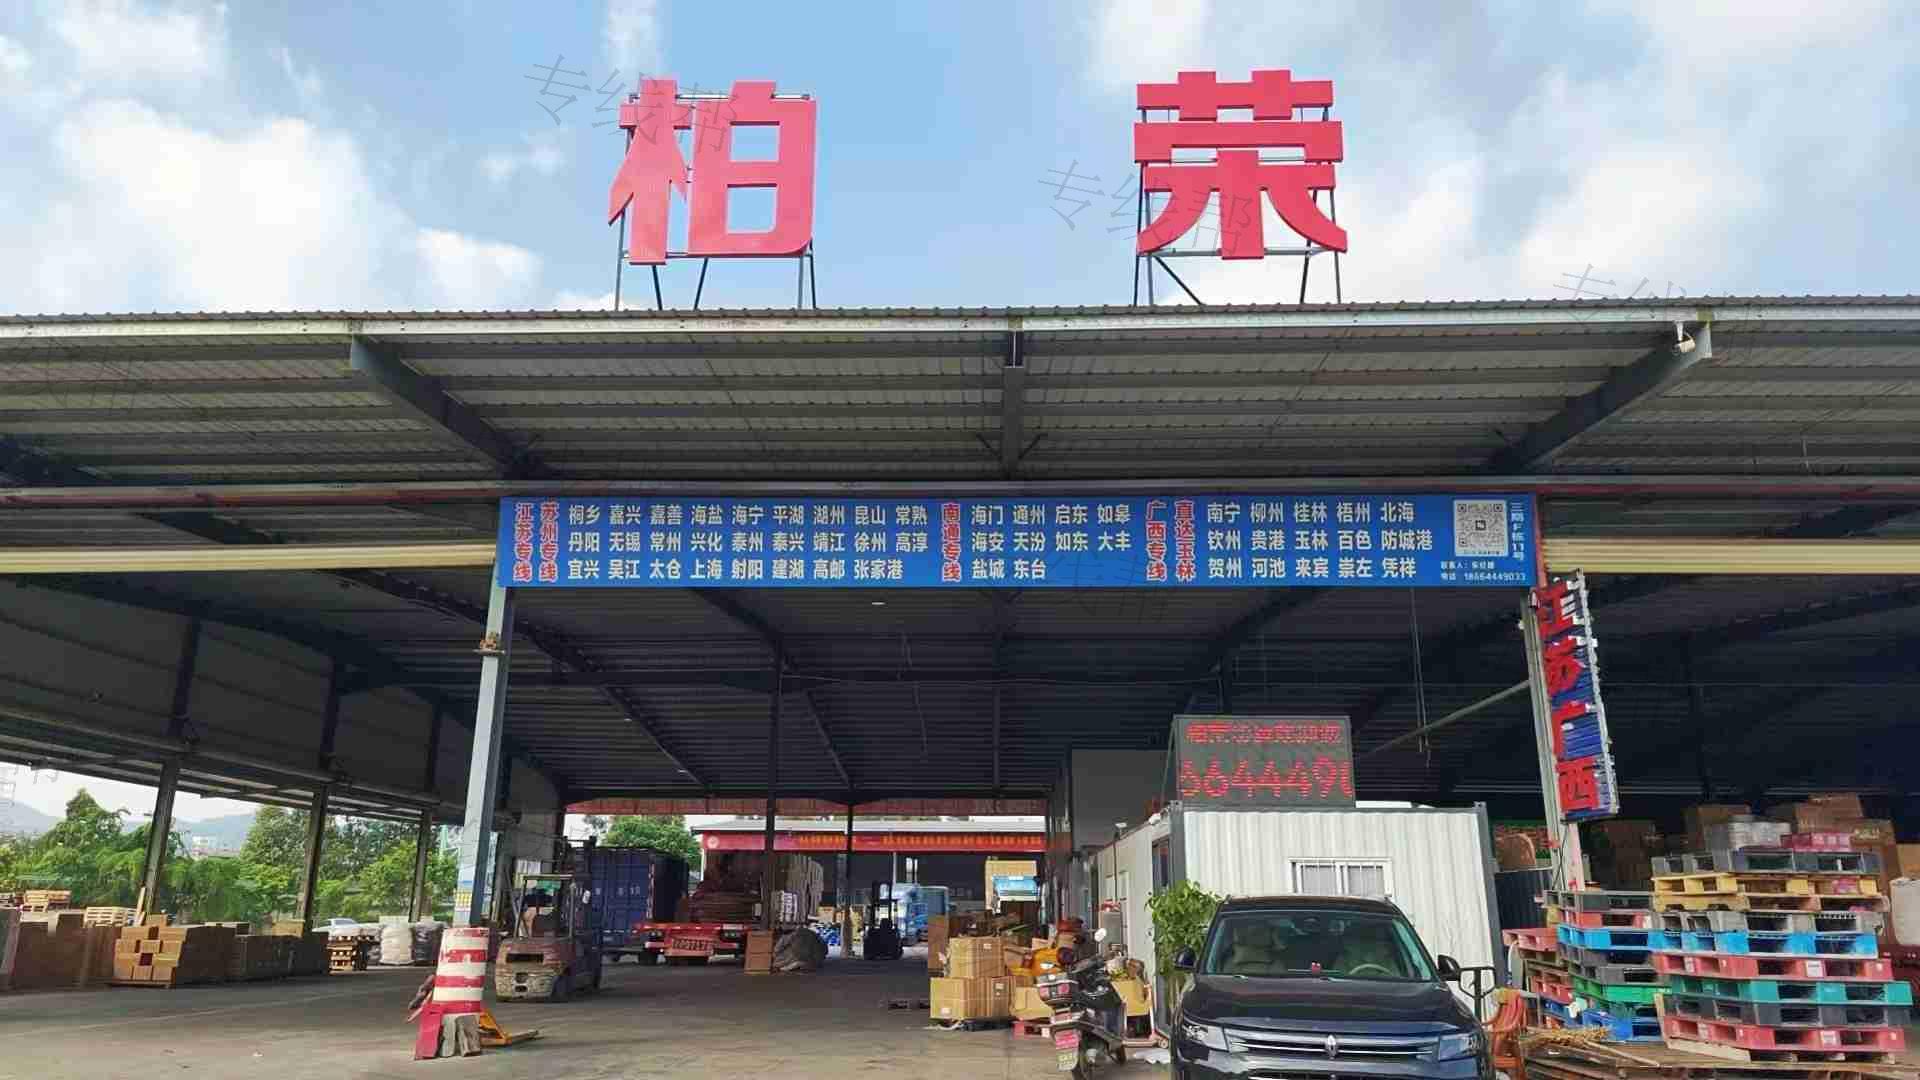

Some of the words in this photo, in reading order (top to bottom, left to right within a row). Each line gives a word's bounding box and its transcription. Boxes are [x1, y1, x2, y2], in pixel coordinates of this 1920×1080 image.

[608, 79, 817, 265] 柏
[1134, 69, 1348, 260] 荣
[569, 505, 600, 525] 桐乡
[609, 505, 640, 525] 嘉兴
[651, 505, 682, 525] 嘉善
[691, 505, 723, 525] 海盐
[732, 505, 764, 525] 海宁
[772, 505, 804, 525] 平湖
[814, 505, 845, 525] 湖州
[855, 505, 886, 525] 昆山
[896, 505, 928, 525] 常熟
[971, 504, 1003, 525] 海门
[1013, 504, 1046, 525] 通州
[1056, 504, 1088, 525] 启东
[1097, 504, 1131, 525] 如皋
[1207, 502, 1240, 523] 南宁
[1250, 502, 1283, 523] 柳州
[1294, 502, 1328, 523] 桂林
[1336, 502, 1370, 523] 梧州
[1380, 502, 1414, 523] 北海
[513, 502, 534, 582] 江苏专线
[539, 502, 559, 582] 苏州专线
[568, 532, 600, 552] 丹阳
[609, 532, 640, 552] 无锡
[650, 532, 681, 552] 常州
[691, 532, 723, 552] 兴化
[731, 532, 763, 552] 泰州
[772, 532, 804, 552] 泰兴
[813, 532, 845, 552] 靖江
[854, 532, 886, 552] 徐州
[895, 532, 928, 552] 高淳
[942, 502, 962, 582] 南通专线
[972, 531, 1003, 552] 海安
[1013, 531, 1046, 552] 天汾
[1056, 531, 1088, 552] 如东
[1098, 531, 1131, 552] 大丰
[1146, 500, 1167, 581] 广西专线
[1175, 500, 1196, 582] 直达玉林
[1207, 529, 1240, 551] 钦州
[1251, 529, 1285, 551] 贵港
[1295, 529, 1328, 551] 玉林
[1338, 529, 1372, 551] 百色
[1381, 529, 1433, 551] 防城港
[568, 559, 600, 579] 宜兴
[608, 559, 640, 579] 吴江
[650, 559, 681, 579] 太仓
[690, 559, 723, 579] 上海
[731, 559, 763, 579] 射阳
[772, 559, 804, 579] 建湖
[813, 559, 845, 579] 高邮
[854, 559, 903, 579] 张家港
[972, 559, 1004, 579] 盐城
[1013, 559, 1046, 579] 东台
[1208, 557, 1242, 578] 贺州
[1251, 557, 1286, 578] 河池
[1295, 557, 1329, 578] 来宾
[1338, 557, 1372, 578] 崇左
[1382, 557, 1416, 578] 凭祥
